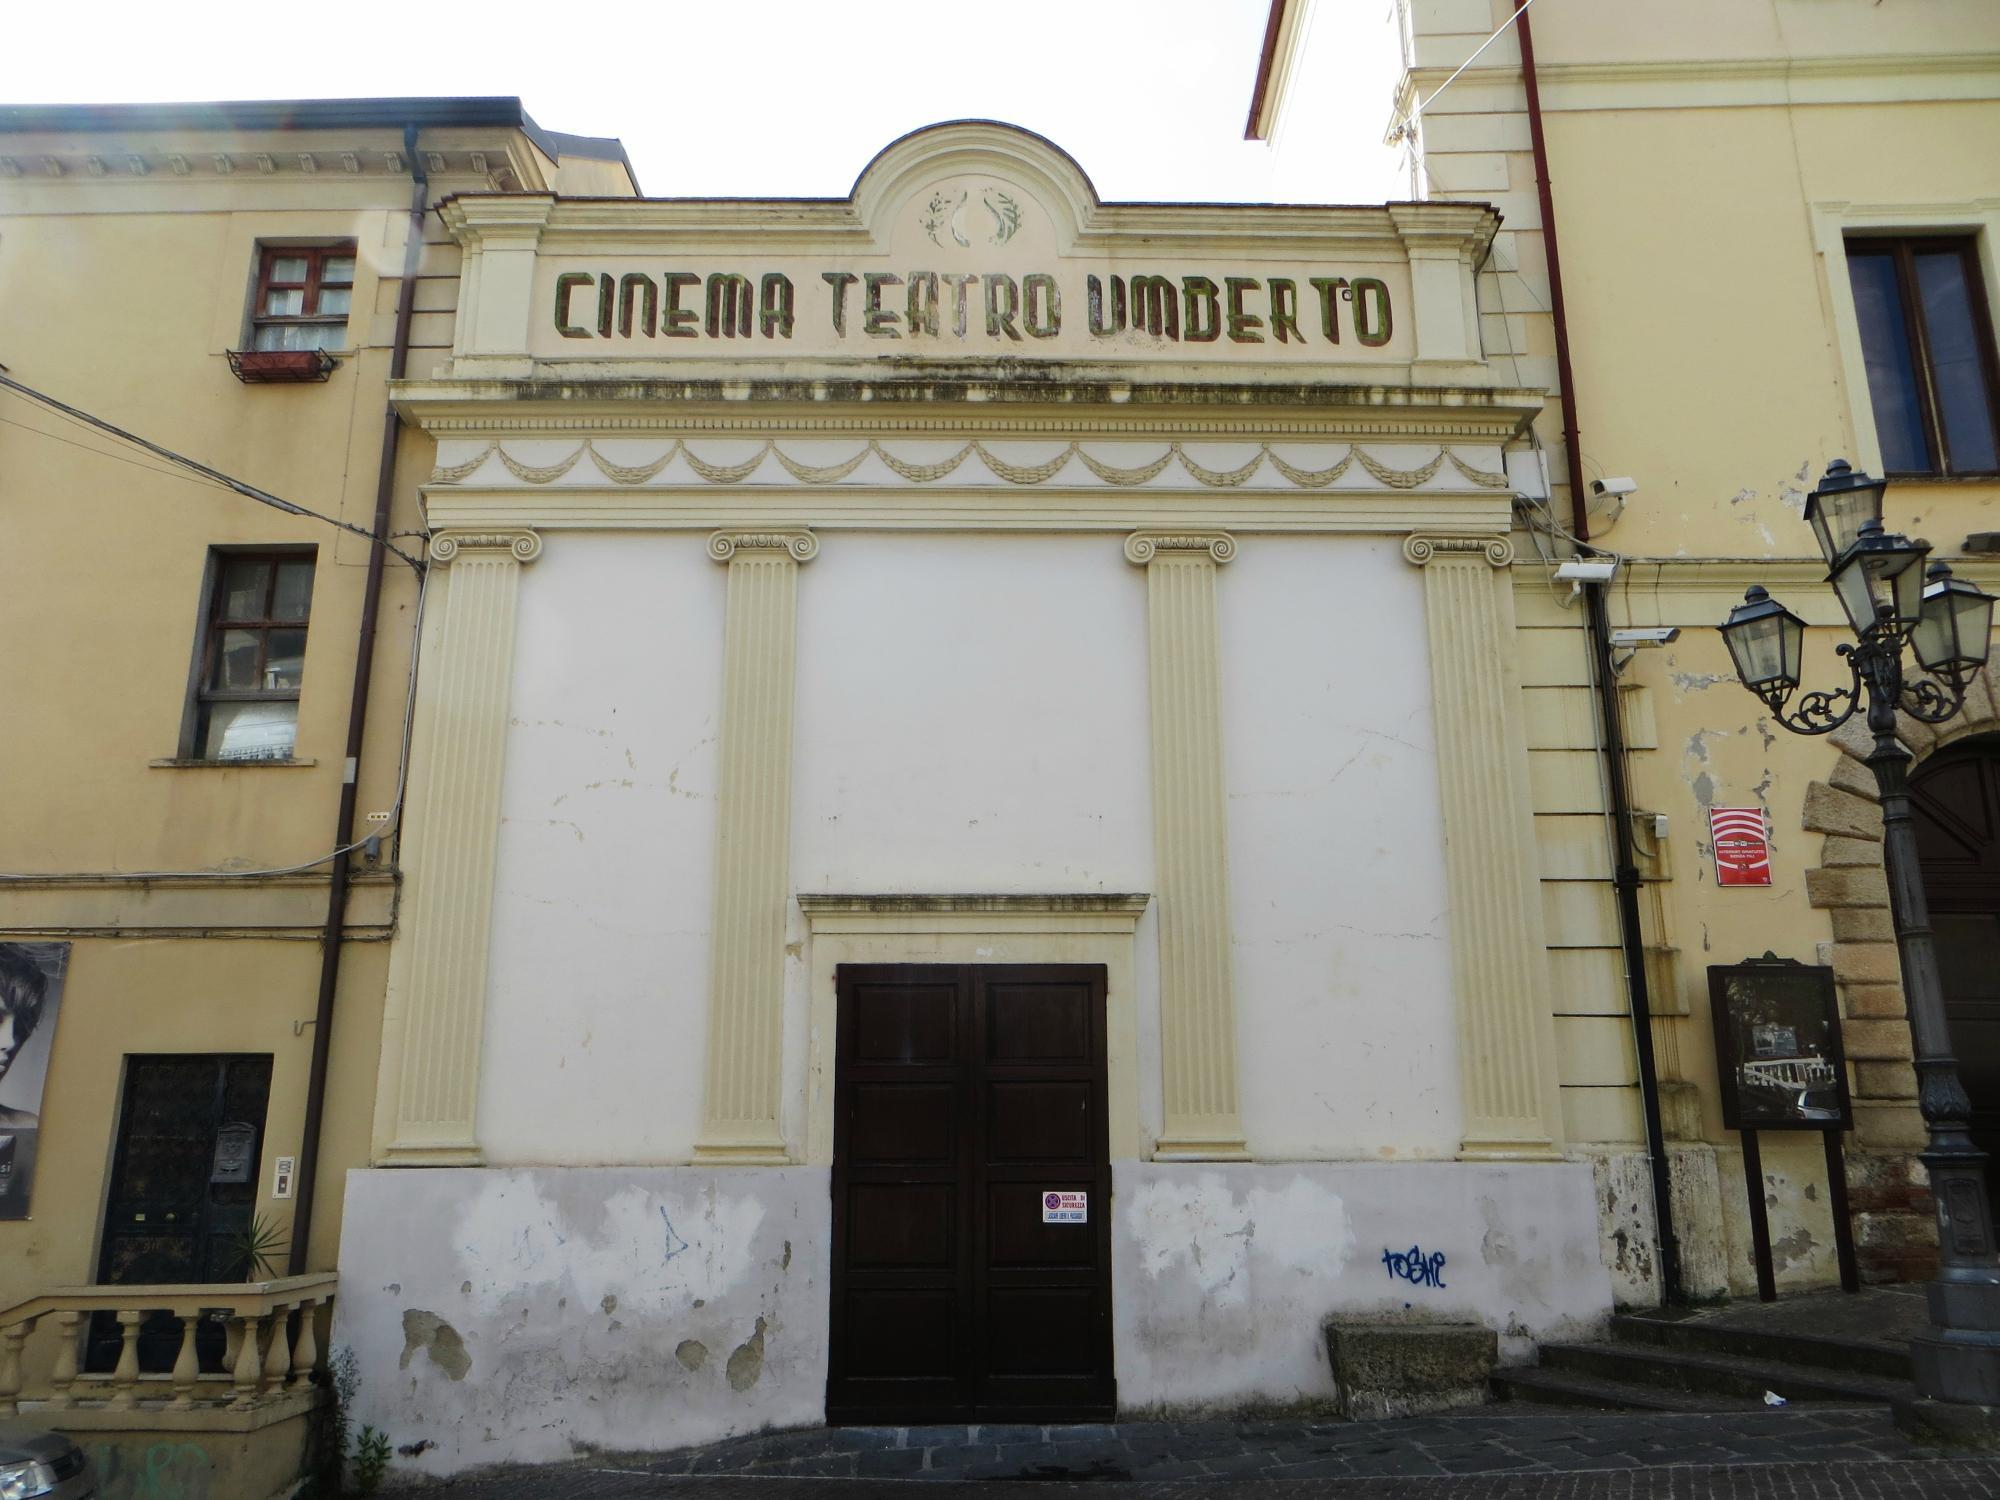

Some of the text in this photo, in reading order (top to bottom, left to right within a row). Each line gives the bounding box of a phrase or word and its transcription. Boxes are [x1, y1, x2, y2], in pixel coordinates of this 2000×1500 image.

[554, 271, 1394, 348] CINEMA TEATRO UMBERTO
